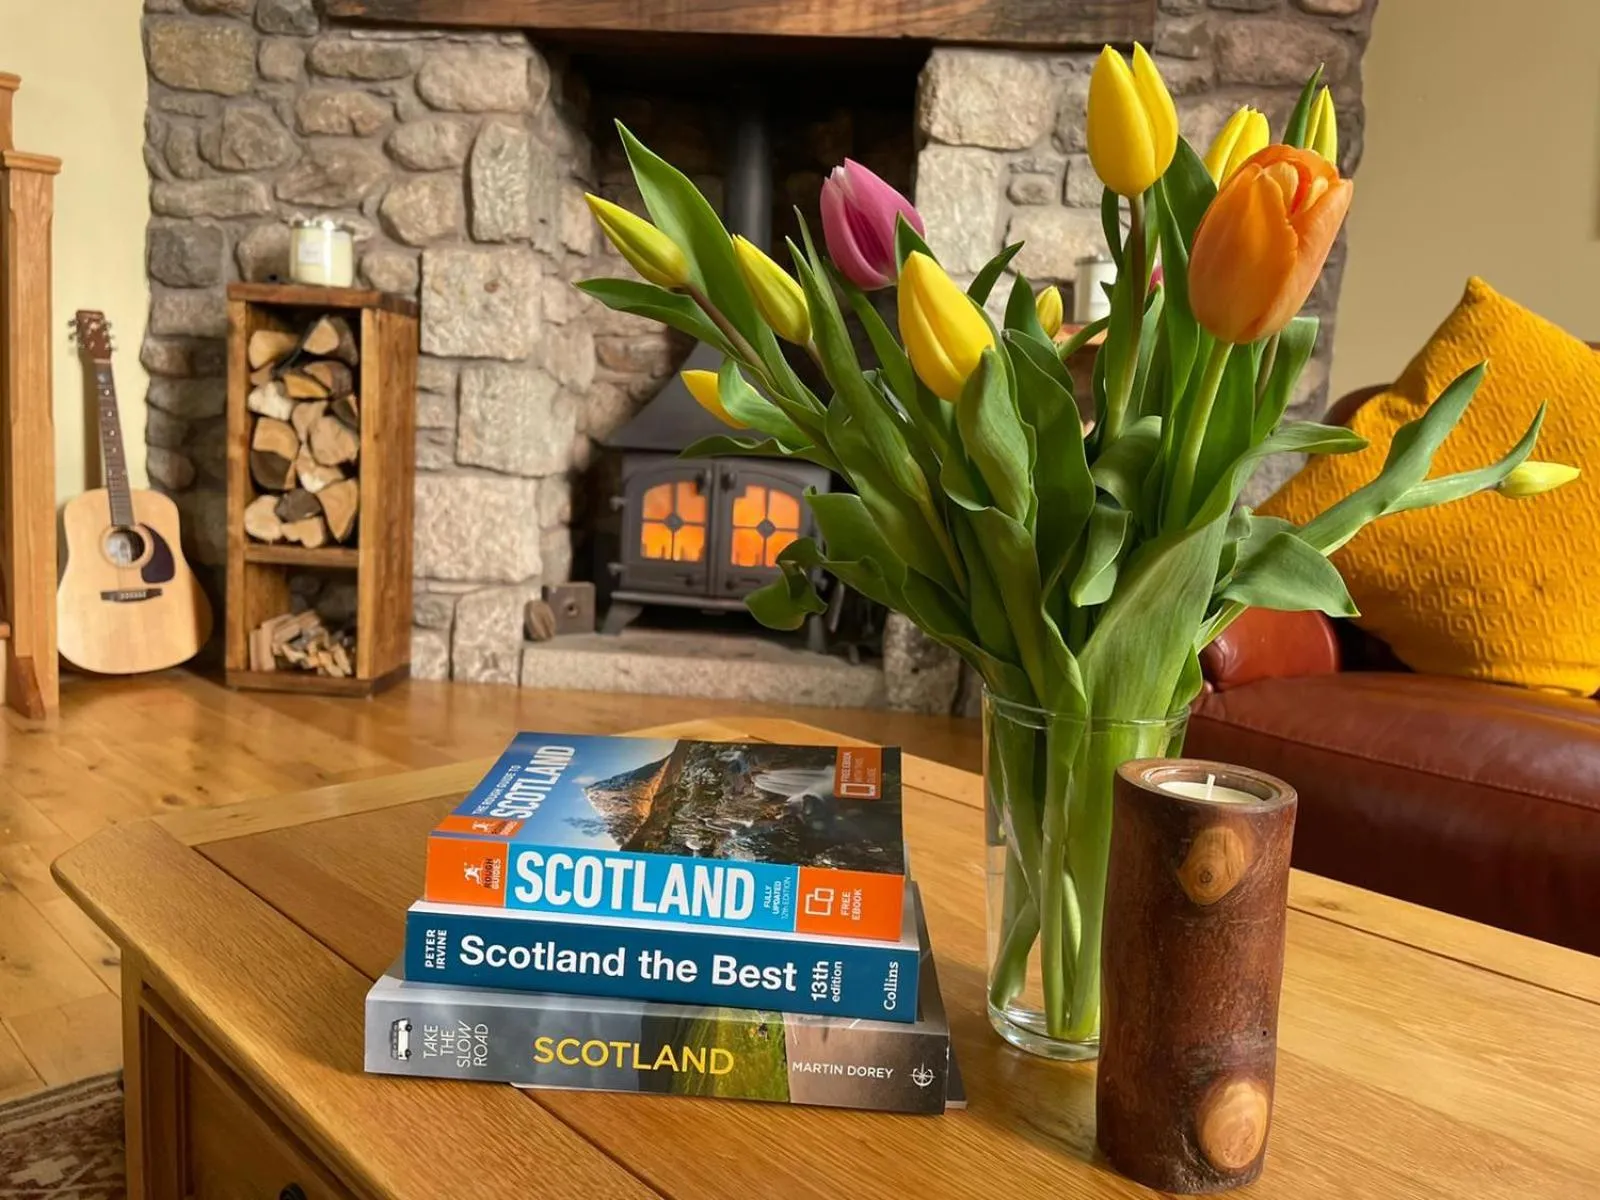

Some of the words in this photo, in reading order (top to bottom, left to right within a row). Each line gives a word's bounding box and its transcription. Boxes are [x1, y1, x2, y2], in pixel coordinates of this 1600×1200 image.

[489, 746, 575, 819] SCOTLAND
[484, 858, 493, 888] ROUGH
[491, 858, 501, 890] GUIDES
[514, 851, 755, 920] SCOTLAND
[782, 876, 791, 904] EDITION
[763, 885, 772, 909] FULLY
[772, 880, 782, 915] UPDATED
[841, 891, 850, 916] FREE
[851, 888, 862, 920] EBOOK
[425, 929, 436, 968] PETER
[436, 929, 447, 969] IRVINE
[459, 934, 626, 977] Scotland
[638, 949, 698, 983] the
[711, 954, 798, 992] Best
[811, 960, 829, 1001] 13th
[831, 961, 842, 1003] edition
[883, 961, 899, 1010] Collins
[423, 1024, 438, 1058] TAKE
[440, 1029, 455, 1056] THE
[456, 1019, 472, 1068] SLOW
[473, 1023, 489, 1067] ROAD
[533, 1036, 735, 1075] SCOTLAND
[792, 1061, 843, 1075] MARTIN
[847, 1065, 894, 1079] DOREY
